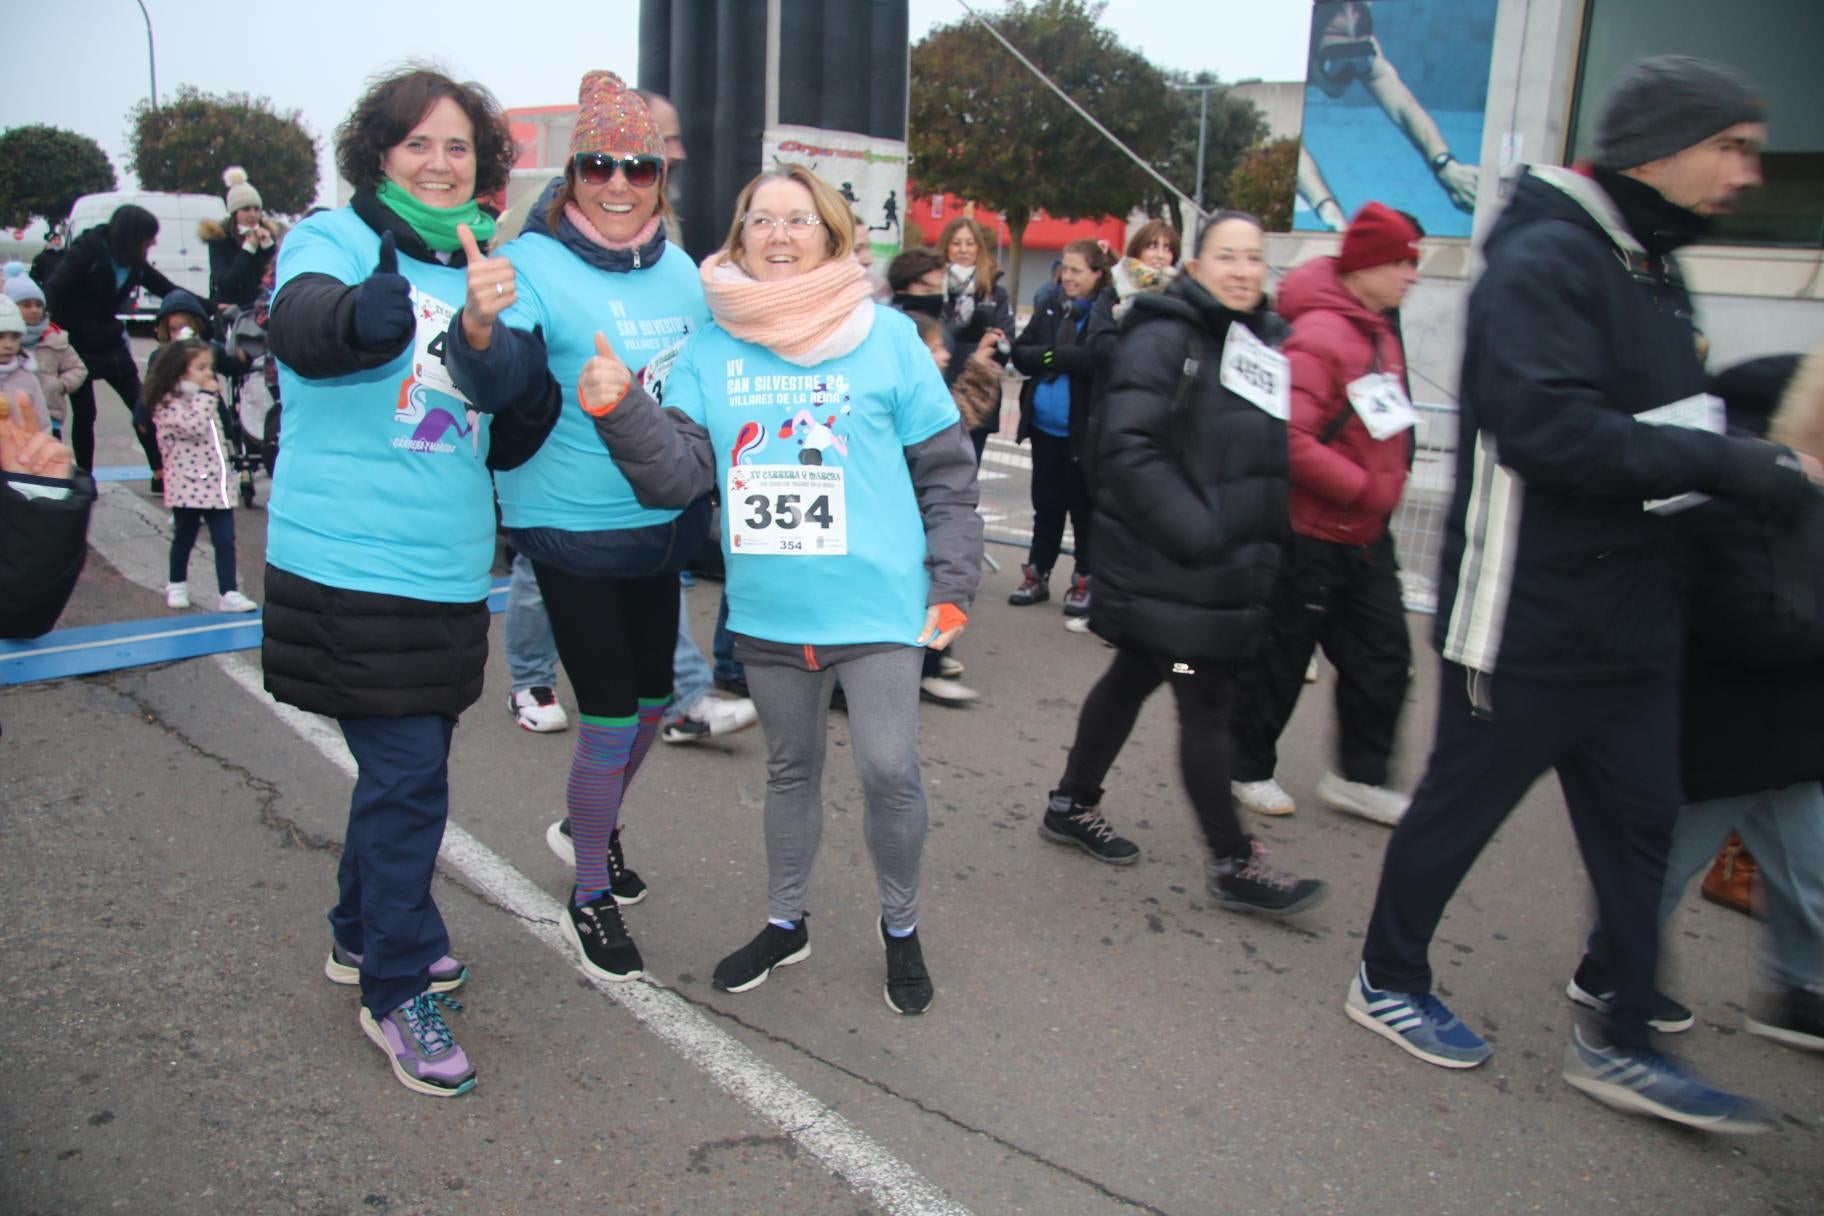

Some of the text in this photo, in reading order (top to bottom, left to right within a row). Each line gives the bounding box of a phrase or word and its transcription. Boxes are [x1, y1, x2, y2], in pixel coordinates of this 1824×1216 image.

[616, 319, 639, 336] SAN
[727, 359, 744, 377] XV
[727, 377, 749, 394] SAN
[755, 375, 821, 391] SILVESTRE
[729, 392, 840, 407] VILLARES DE LA REINA
[750, 471, 841, 481] XV CARRERA Y MARCHA
[744, 494, 833, 530] 354
[779, 541, 802, 550] 354
